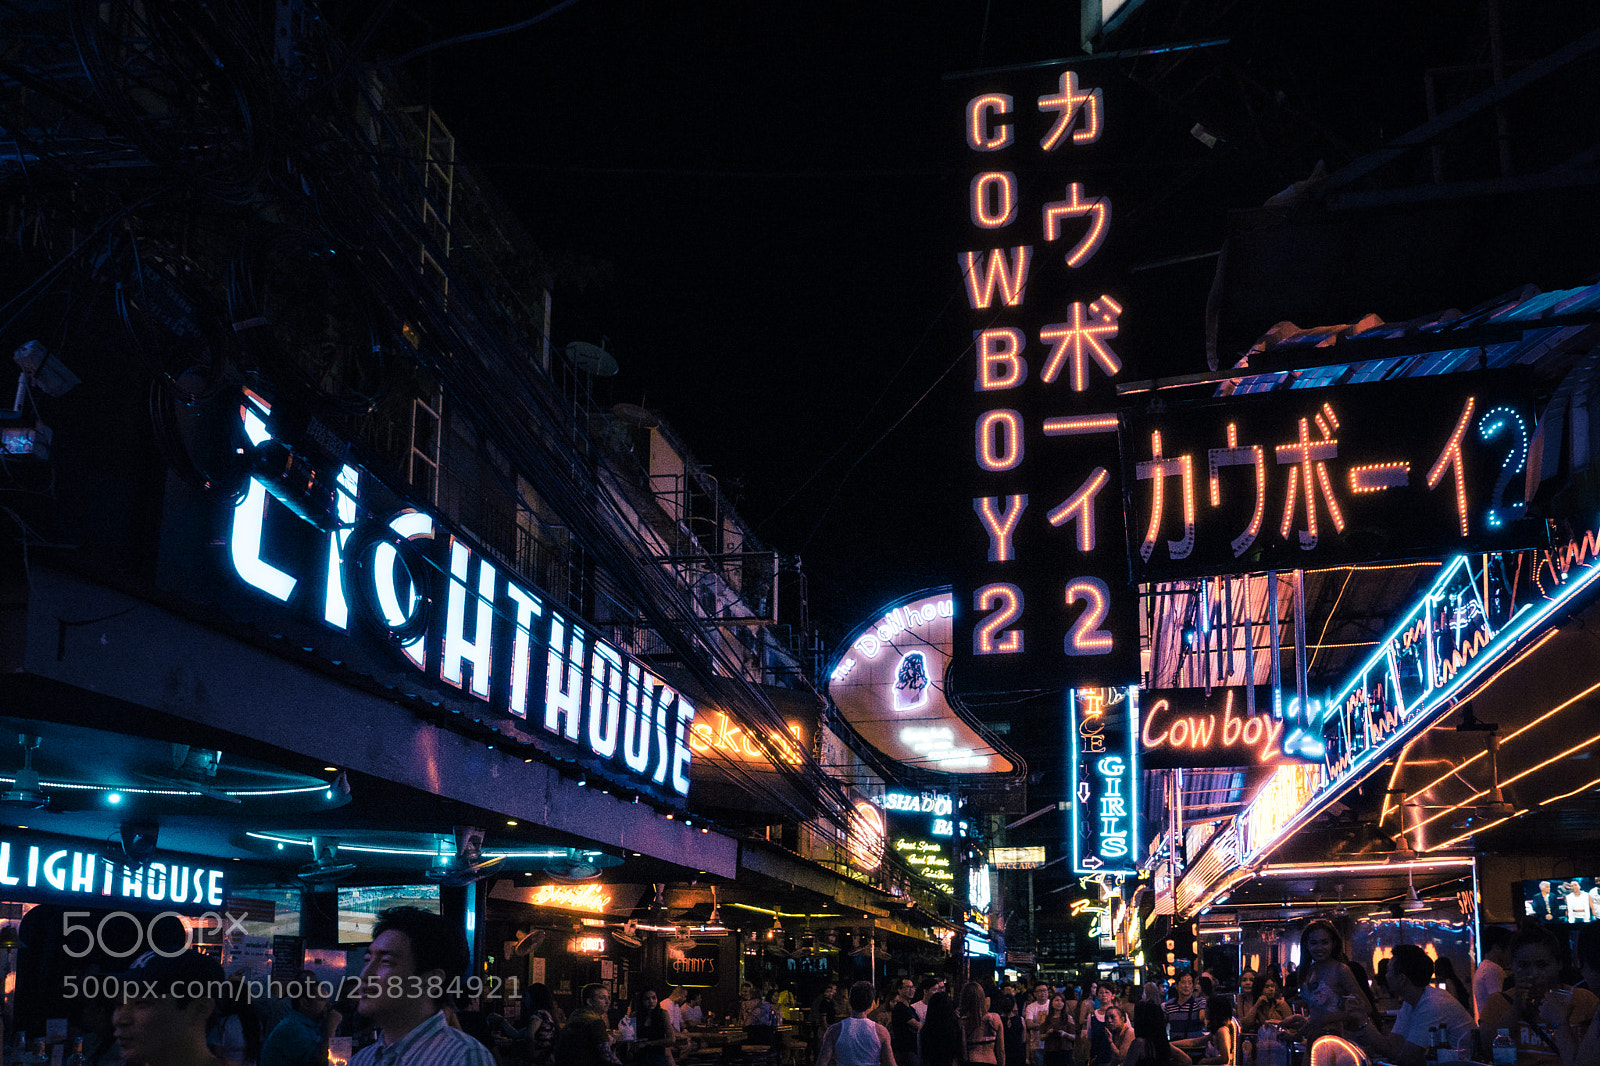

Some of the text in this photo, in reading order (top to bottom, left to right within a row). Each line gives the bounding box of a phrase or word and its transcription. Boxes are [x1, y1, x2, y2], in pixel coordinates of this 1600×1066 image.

[830, 600, 954, 681] The Dollhou
[1079, 687, 1107, 753] ICE
[1098, 756, 1129, 858] GIRLS
[0, 841, 224, 906] LIGHTHOUSE
